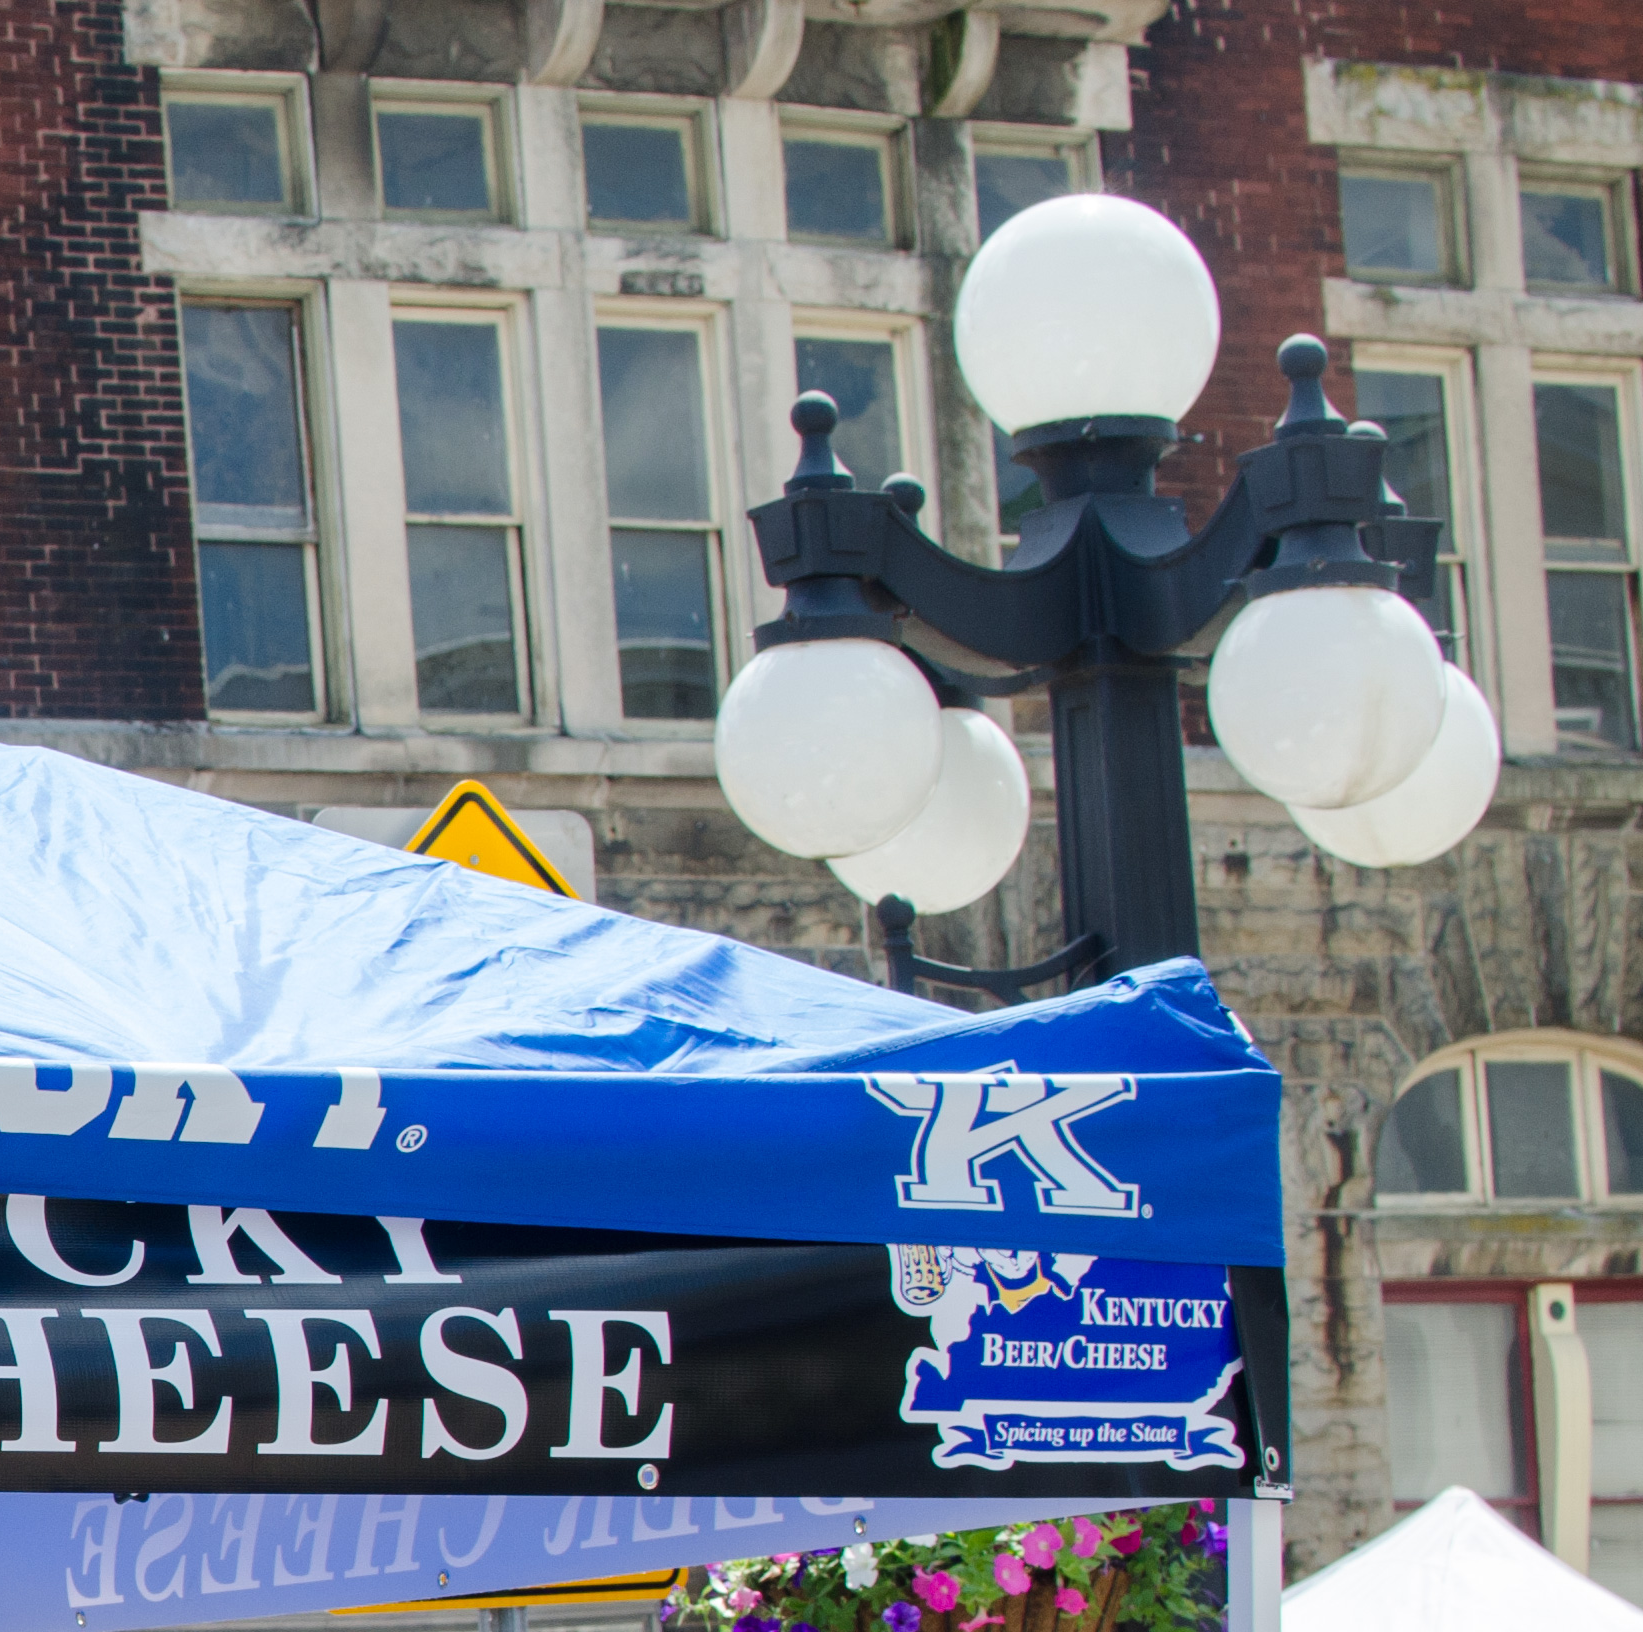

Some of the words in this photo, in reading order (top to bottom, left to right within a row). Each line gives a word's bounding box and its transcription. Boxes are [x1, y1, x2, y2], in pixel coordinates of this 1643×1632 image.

[1080, 1288, 1227, 1329] KENTUCKY
[981, 1334, 1167, 1371] BEER/CHEESE
[995, 1421, 1064, 1447] Spicing
[1069, 1427, 1092, 1446] up
[1097, 1422, 1127, 1442] the
[1130, 1422, 1177, 1443] State
